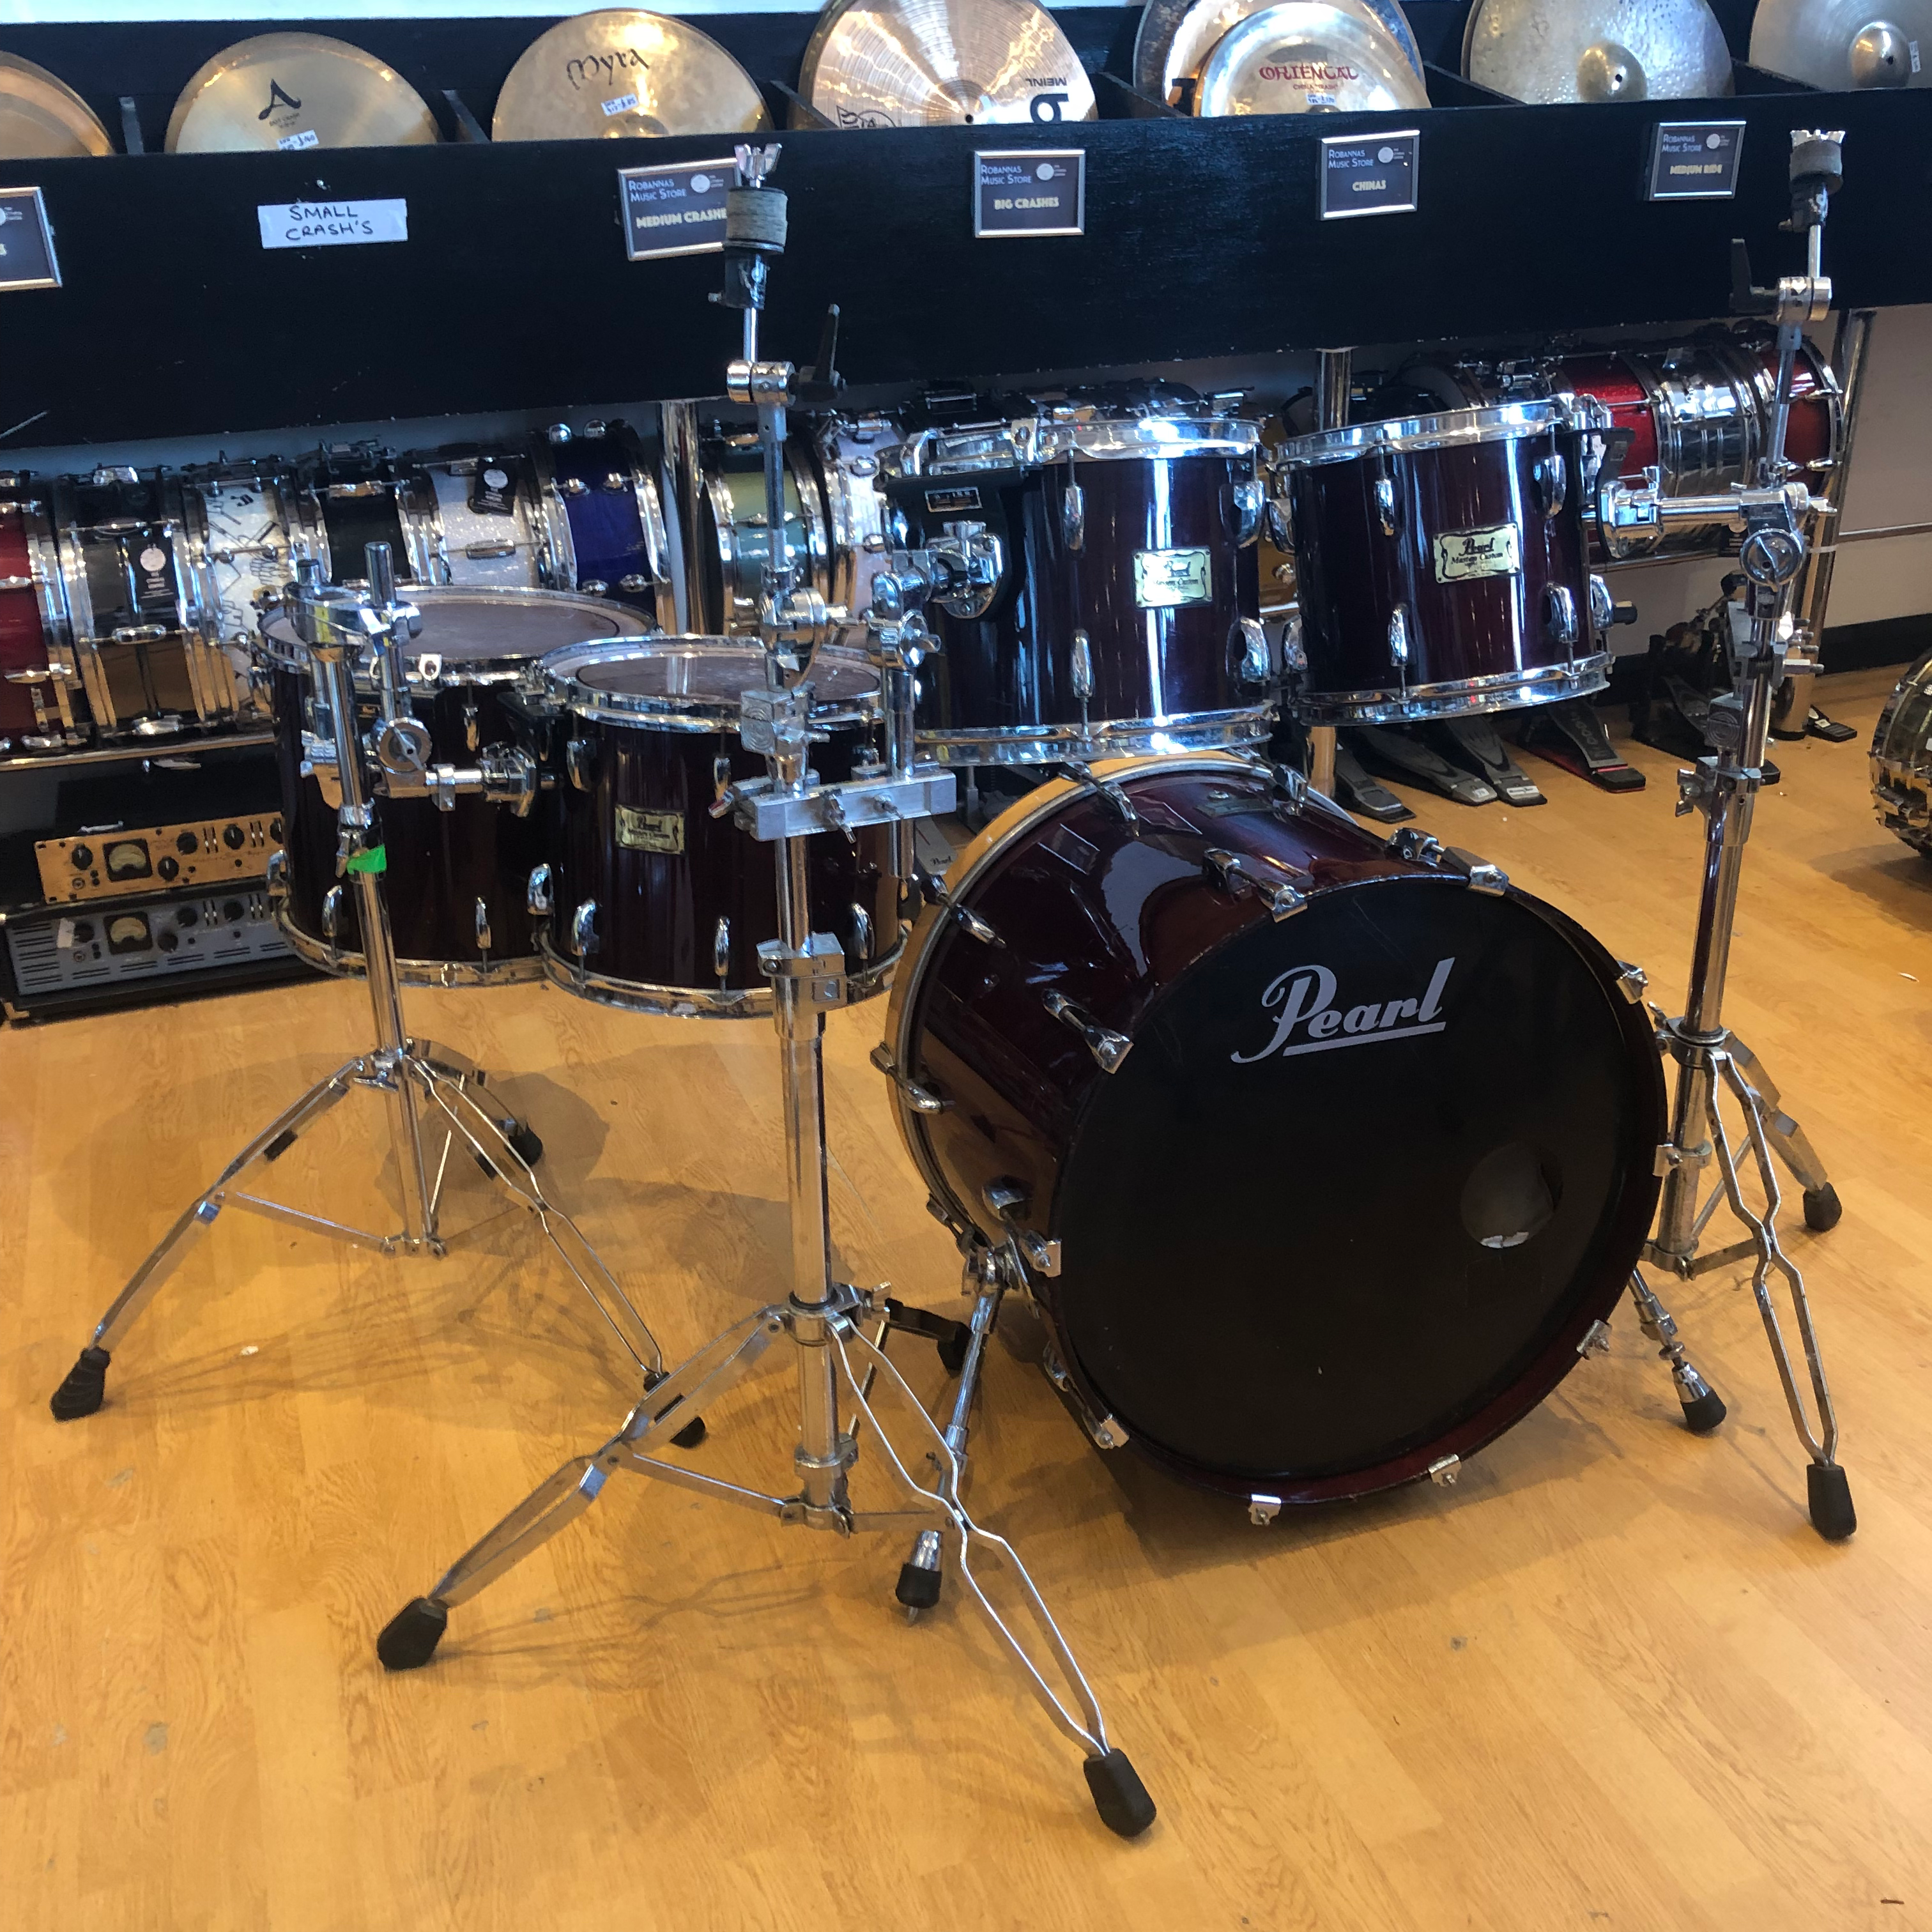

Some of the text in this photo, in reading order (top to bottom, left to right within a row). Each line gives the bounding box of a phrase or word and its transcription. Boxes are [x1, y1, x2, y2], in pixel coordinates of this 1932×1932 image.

[1025, 77, 1068, 86] MEINL
[1328, 150, 1365, 158] ROBANNAS
[981, 165, 1022, 175] ROBANNAS
[1328, 158, 1374, 169] MUSIC STORE
[628, 178, 675, 192] ROBANNAS
[981, 174, 1032, 185] MUSIC STORE
[1353, 180, 1386, 192] CHINAS
[630, 188, 687, 203] MUSIC STORE
[994, 196, 1059, 210] BIG CRASHES
[289, 205, 358, 221] SMALL
[636, 207, 728, 229] MEDIUM CRASHE
[286, 220, 373, 241] CRASH'S
[1458, 537, 1495, 556] Pearl
[1230, 956, 1455, 1064] Pearl
